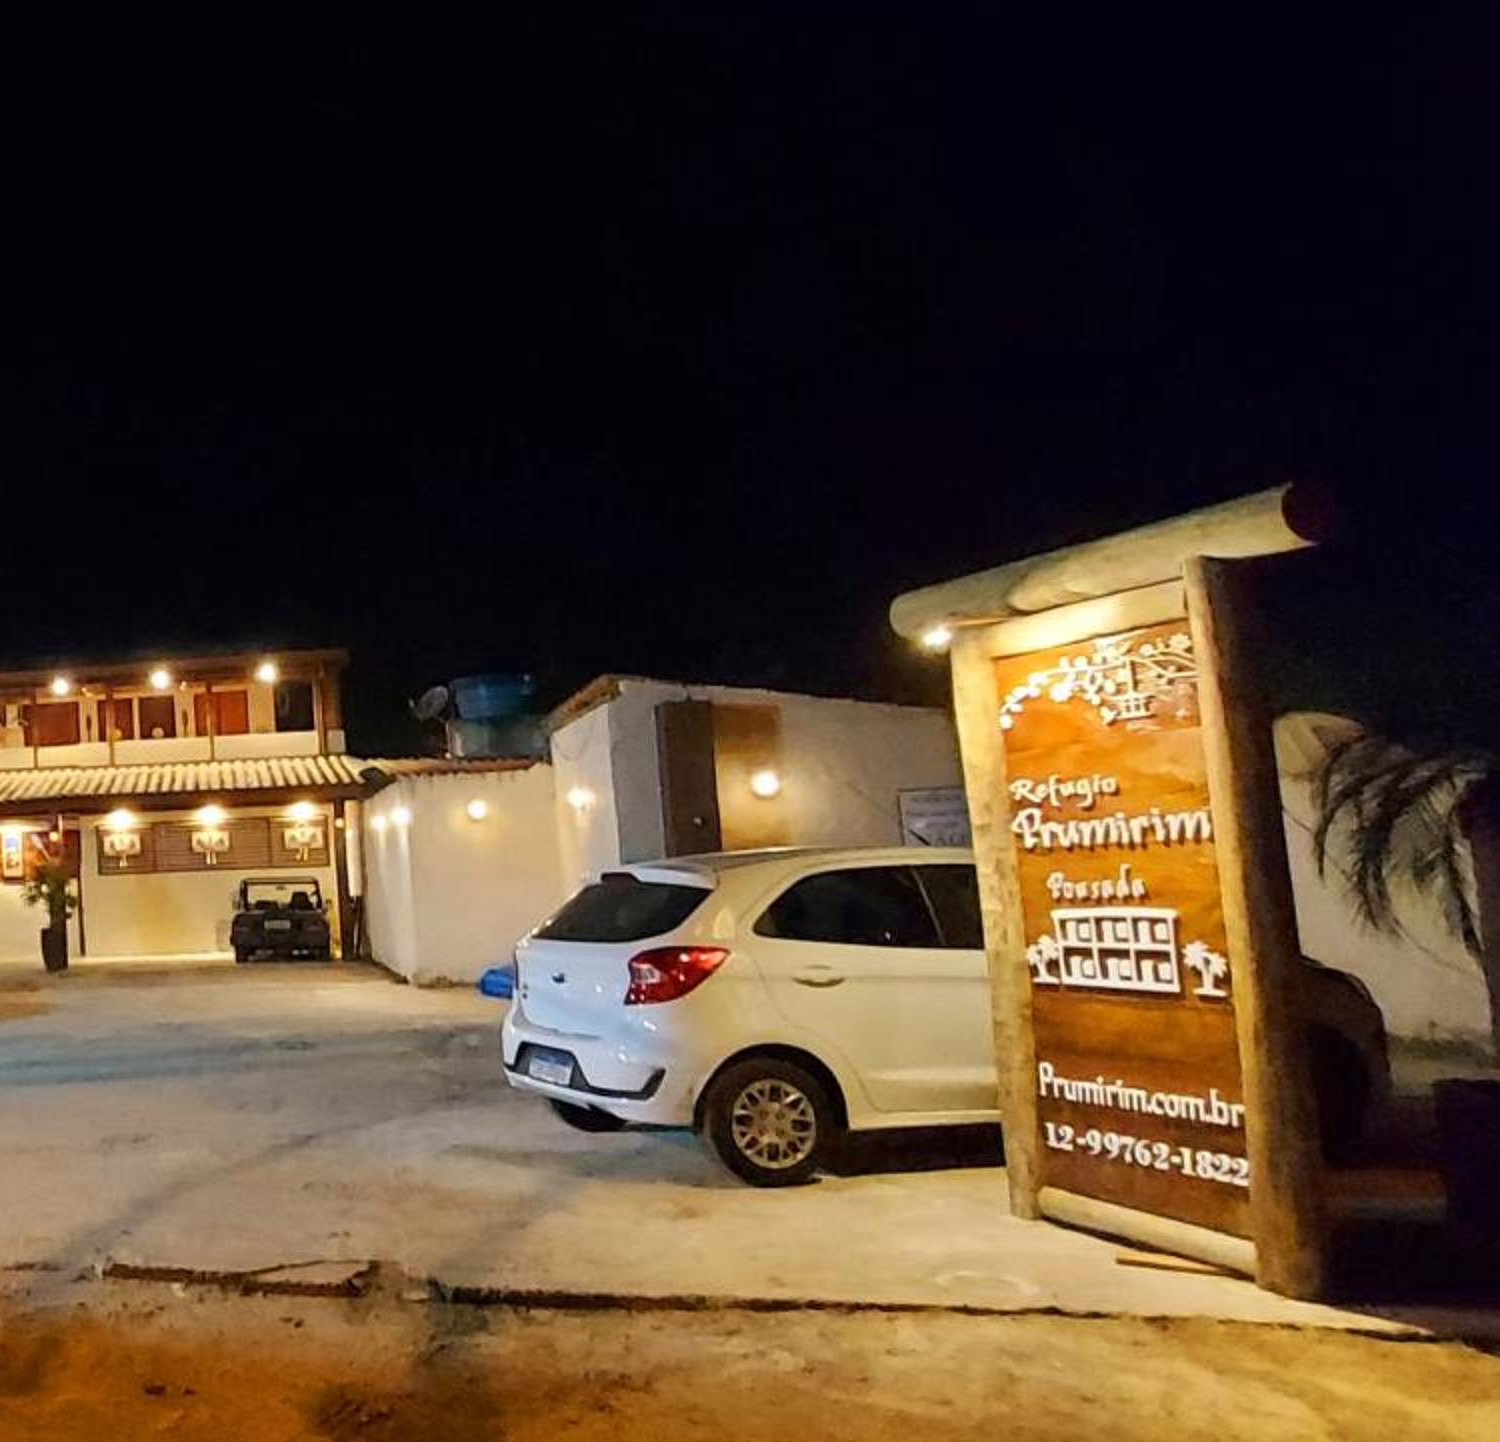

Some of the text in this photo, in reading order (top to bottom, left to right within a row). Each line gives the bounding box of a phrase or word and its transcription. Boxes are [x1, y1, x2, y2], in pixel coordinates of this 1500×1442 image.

[1008, 774, 1119, 807] Refugio
[1011, 808, 1211, 850] Prumirim
[1046, 863, 1146, 899] Pousada
[1038, 1061, 1246, 1128] Prumirim.com.br
[1044, 1121, 1250, 1187] 12-99762-1822
